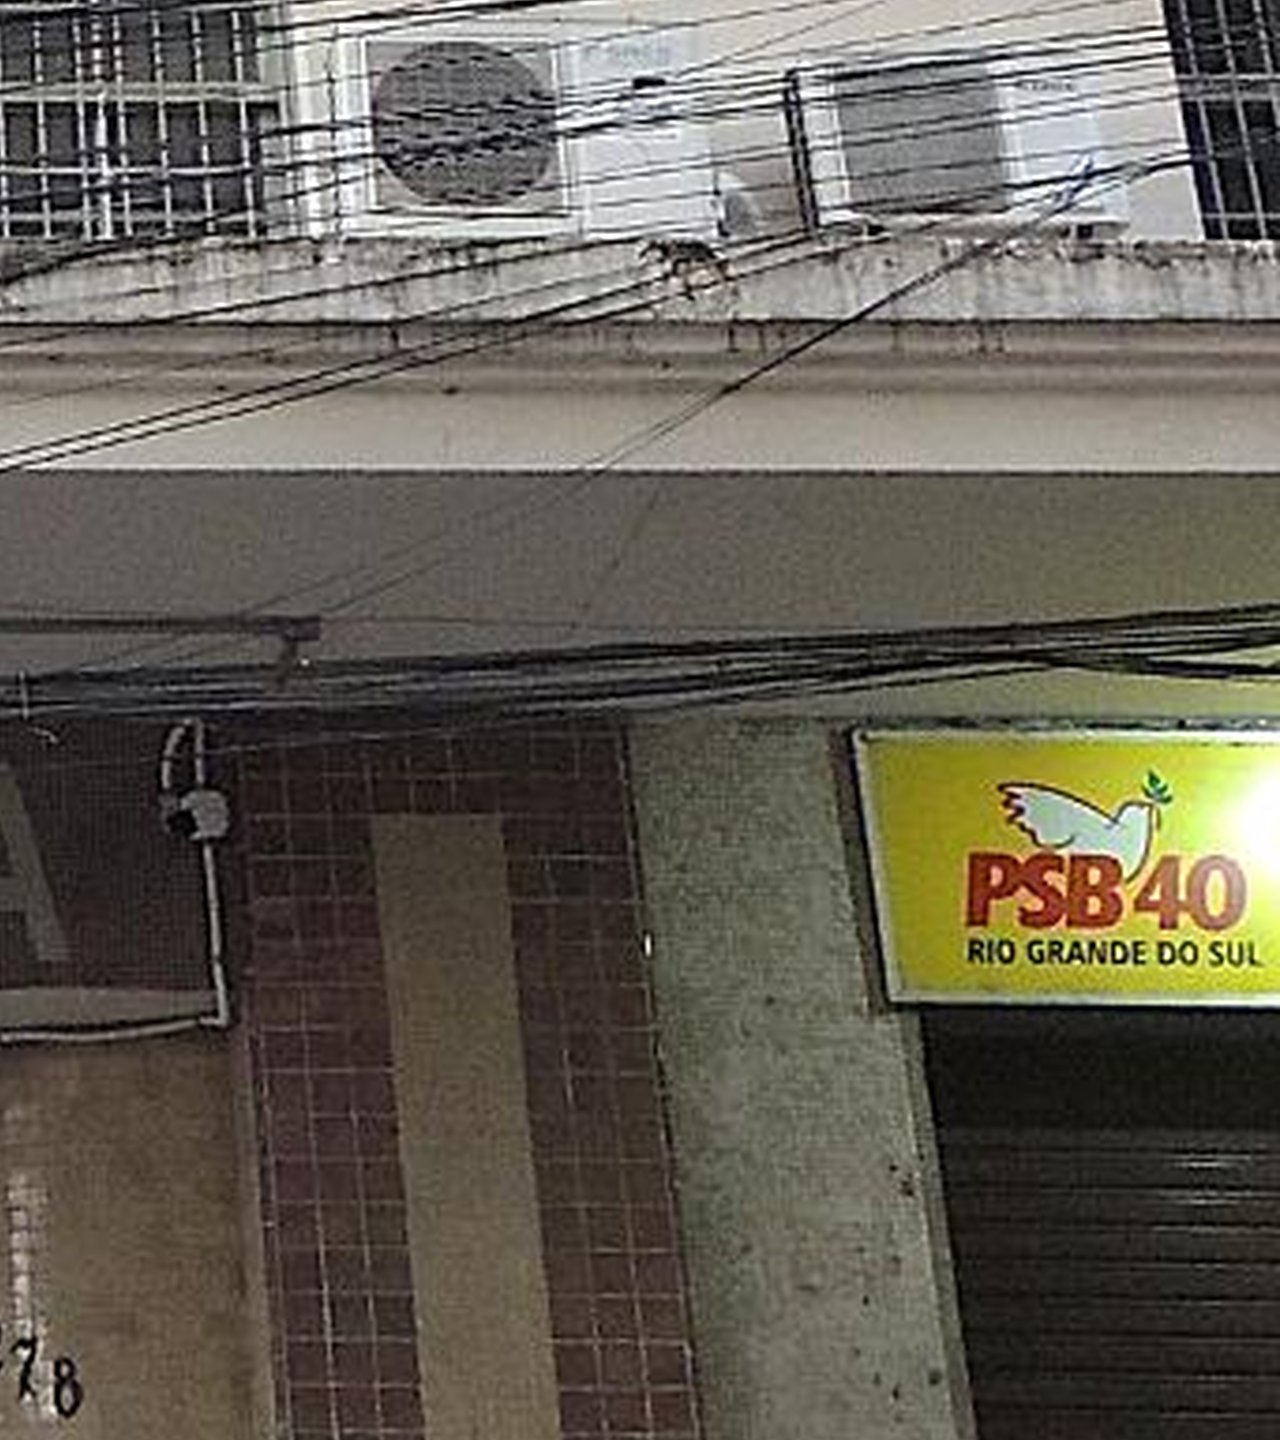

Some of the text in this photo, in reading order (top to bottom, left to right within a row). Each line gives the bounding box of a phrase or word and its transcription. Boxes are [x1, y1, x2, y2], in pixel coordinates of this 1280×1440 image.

[965, 852, 1246, 931] PSB 40
[967, 939, 1263, 967] RIO GRANDE DO SUL
